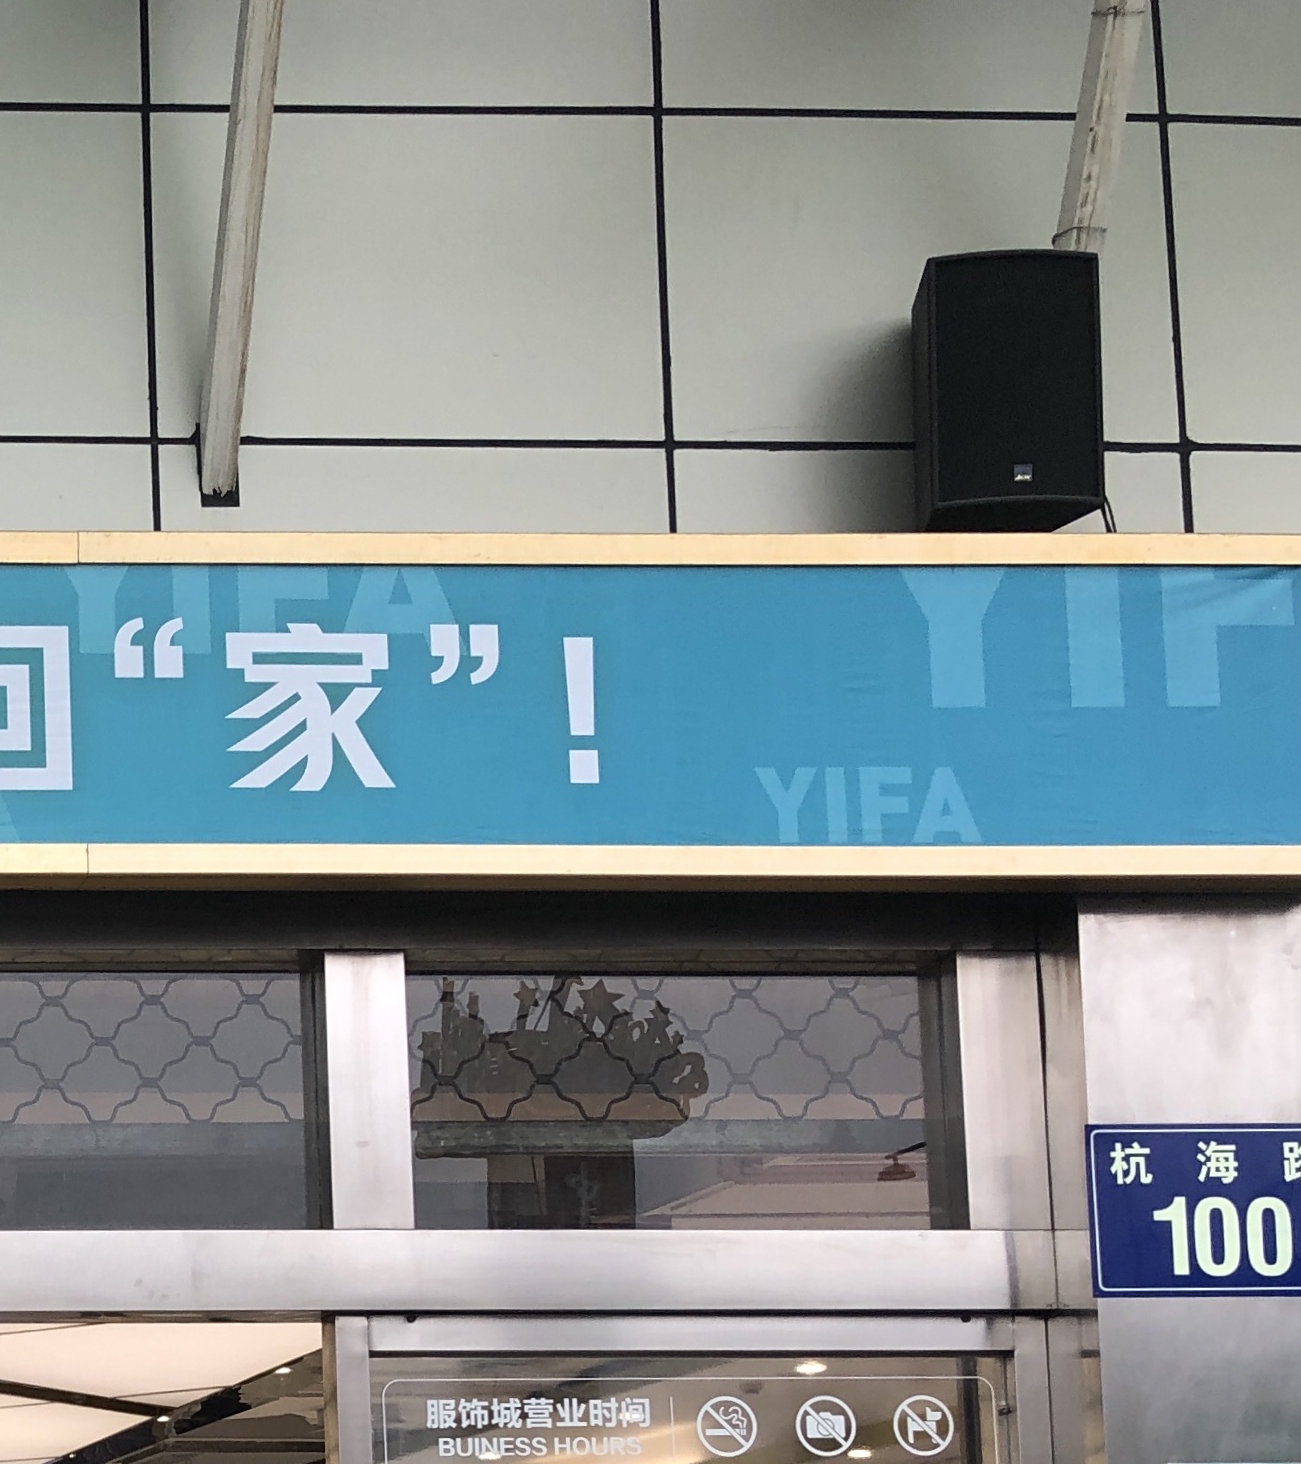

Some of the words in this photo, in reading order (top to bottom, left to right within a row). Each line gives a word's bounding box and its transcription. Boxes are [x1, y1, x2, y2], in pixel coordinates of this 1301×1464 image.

[754, 766, 982, 843] YIFA
[1153, 1196, 1293, 1278] 100
[426, 1397, 651, 1429] 服饰城营业时间
[438, 1437, 548, 1458] BUINESS
[553, 1436, 642, 1456] HOURS
